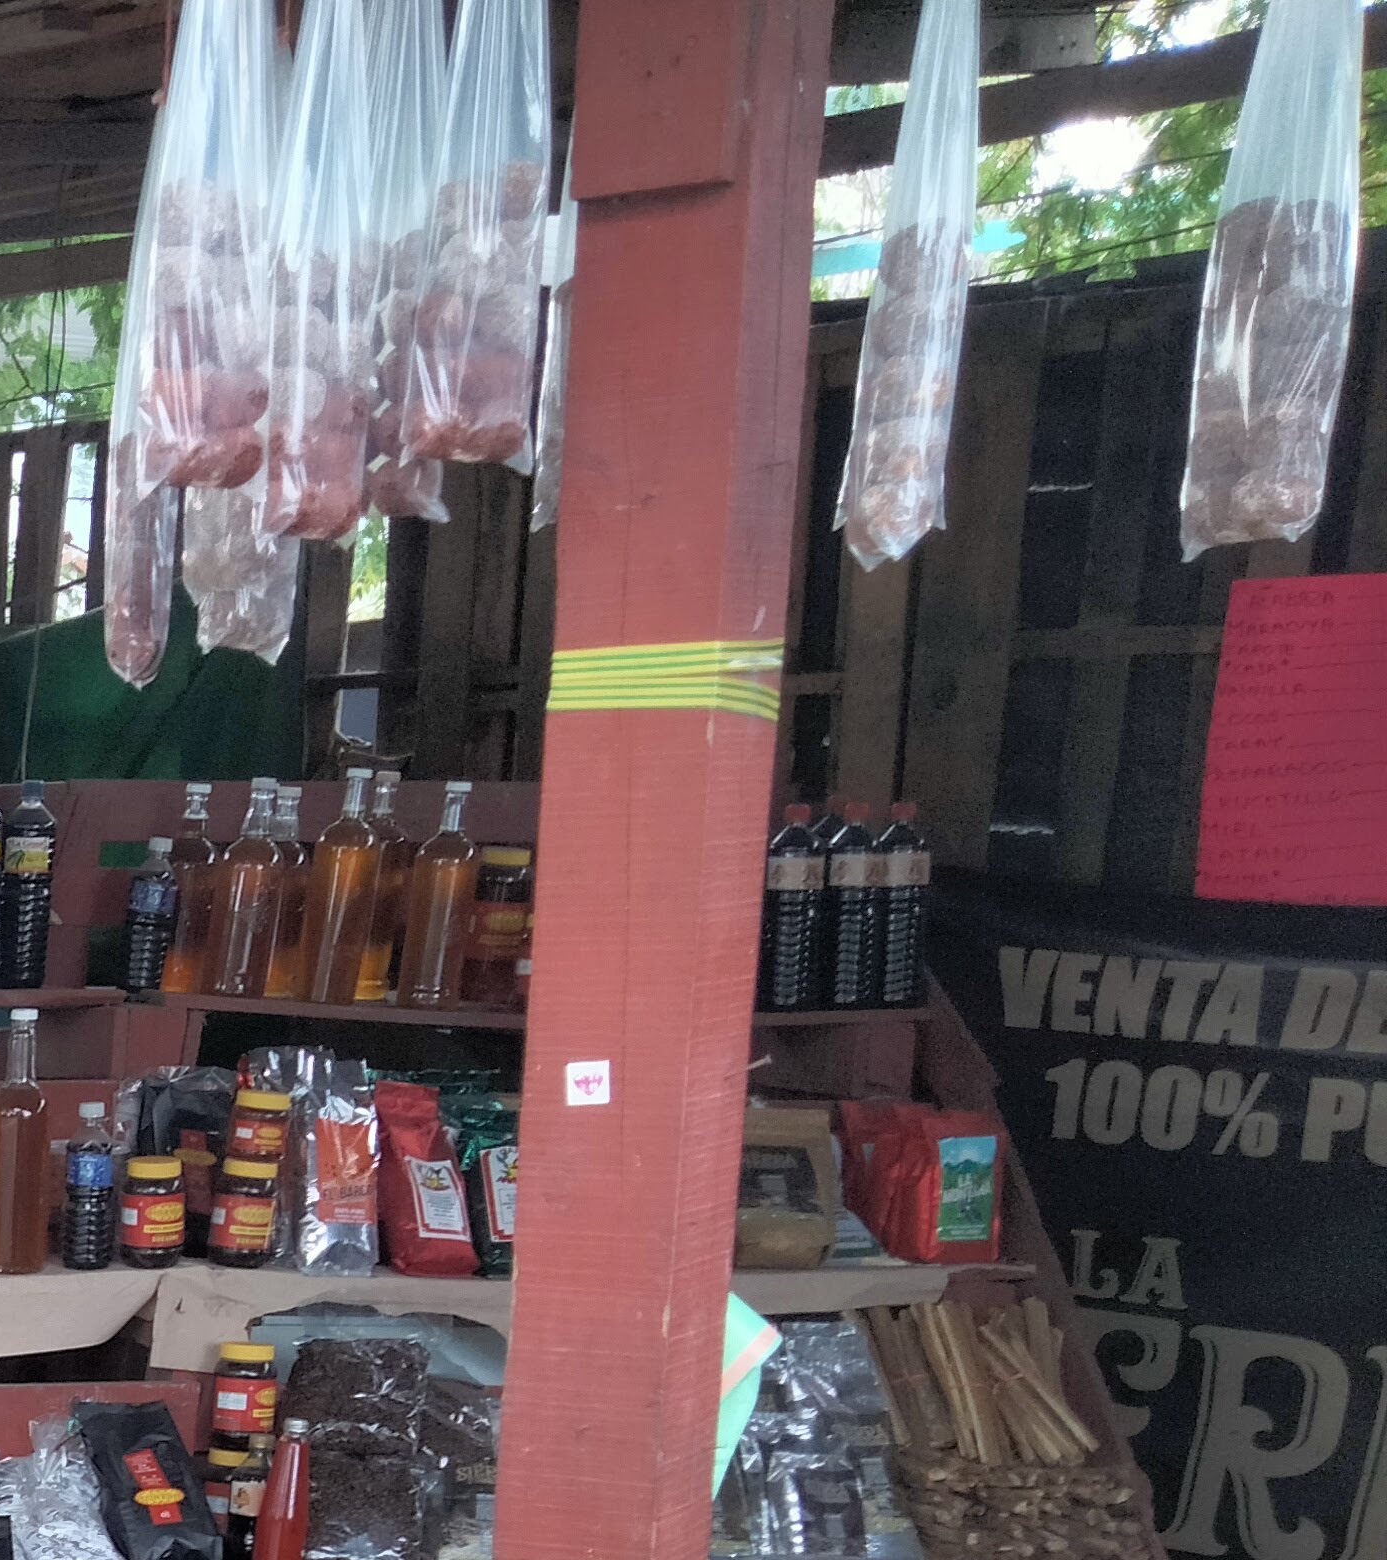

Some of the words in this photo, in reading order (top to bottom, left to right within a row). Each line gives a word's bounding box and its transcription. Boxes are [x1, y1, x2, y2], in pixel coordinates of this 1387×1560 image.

[998, 945, 1265, 1047] VENTA
[1045, 1057, 1279, 1159] 100%
[1069, 1228, 1188, 1309] LA
